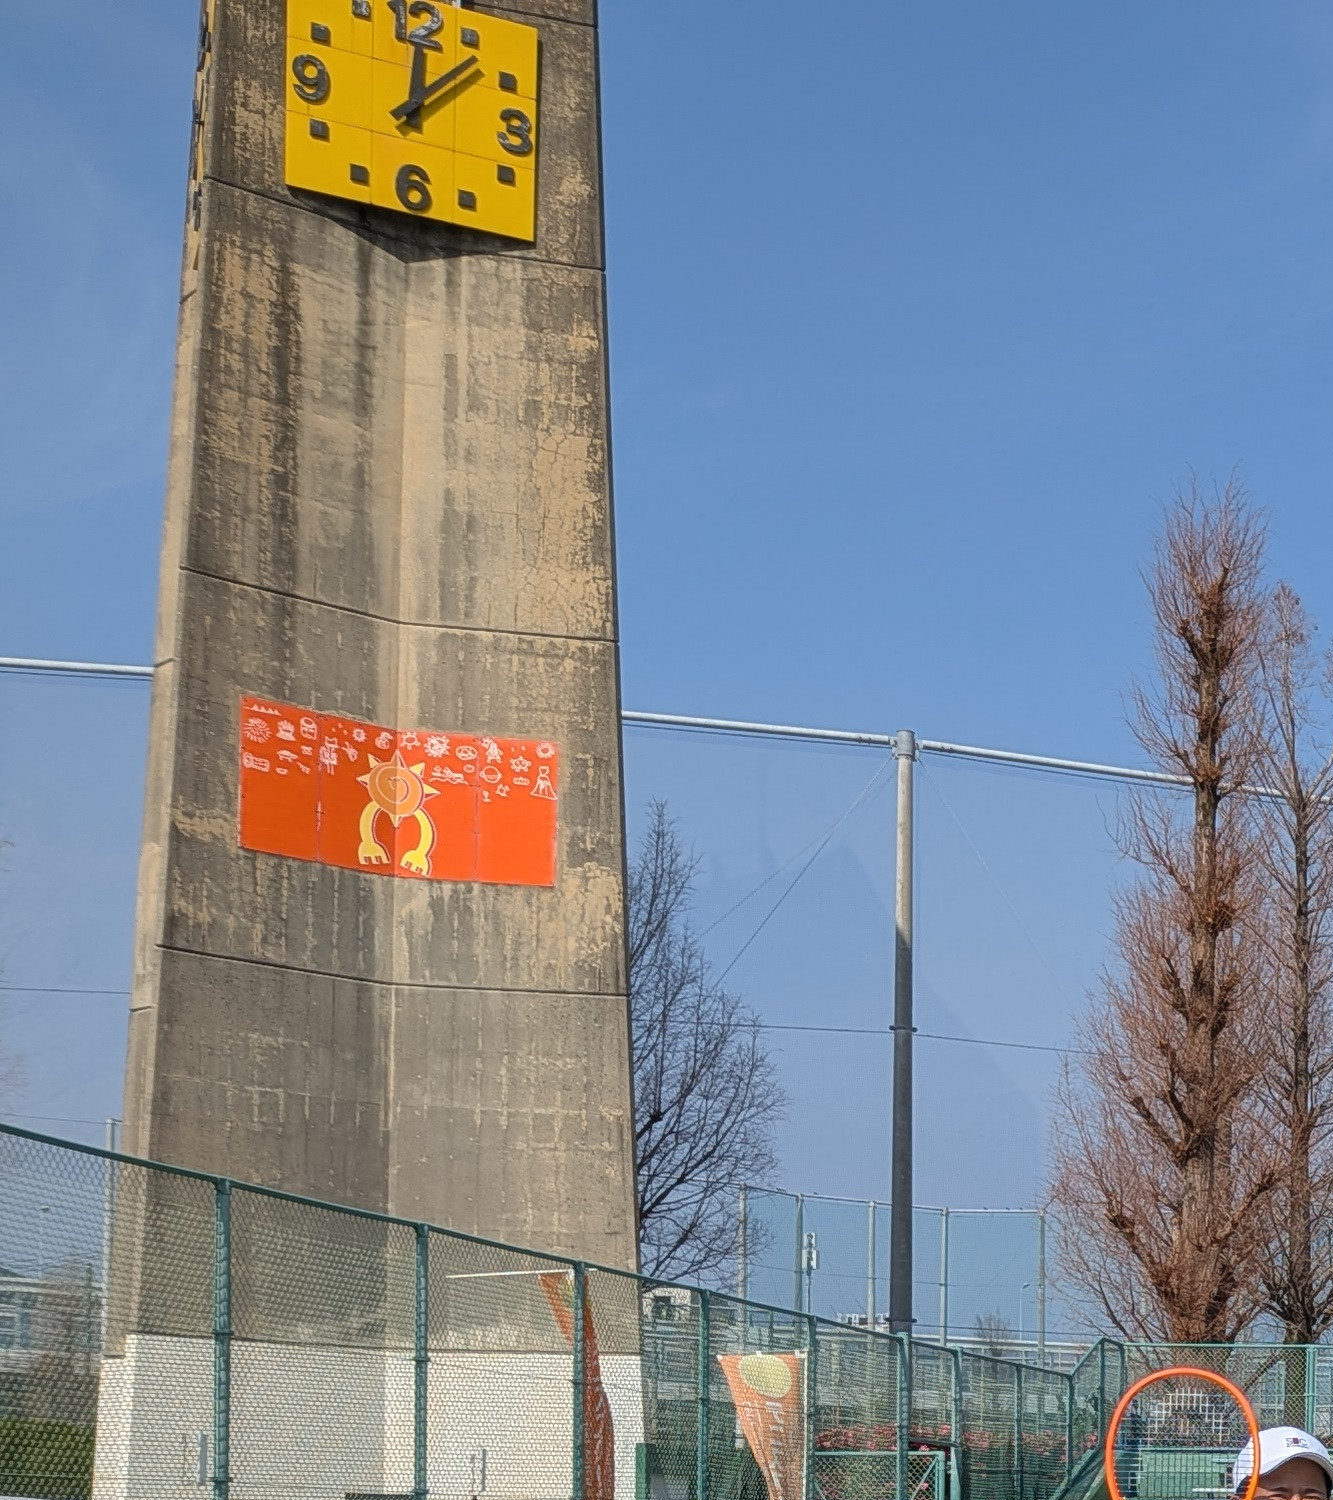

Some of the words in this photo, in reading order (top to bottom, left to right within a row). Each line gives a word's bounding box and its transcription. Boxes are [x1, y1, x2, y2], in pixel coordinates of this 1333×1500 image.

[387, 0, 443, 52] 12
[292, 54, 329, 103] 9
[496, 108, 533, 156] 3
[396, 164, 432, 214] 6
